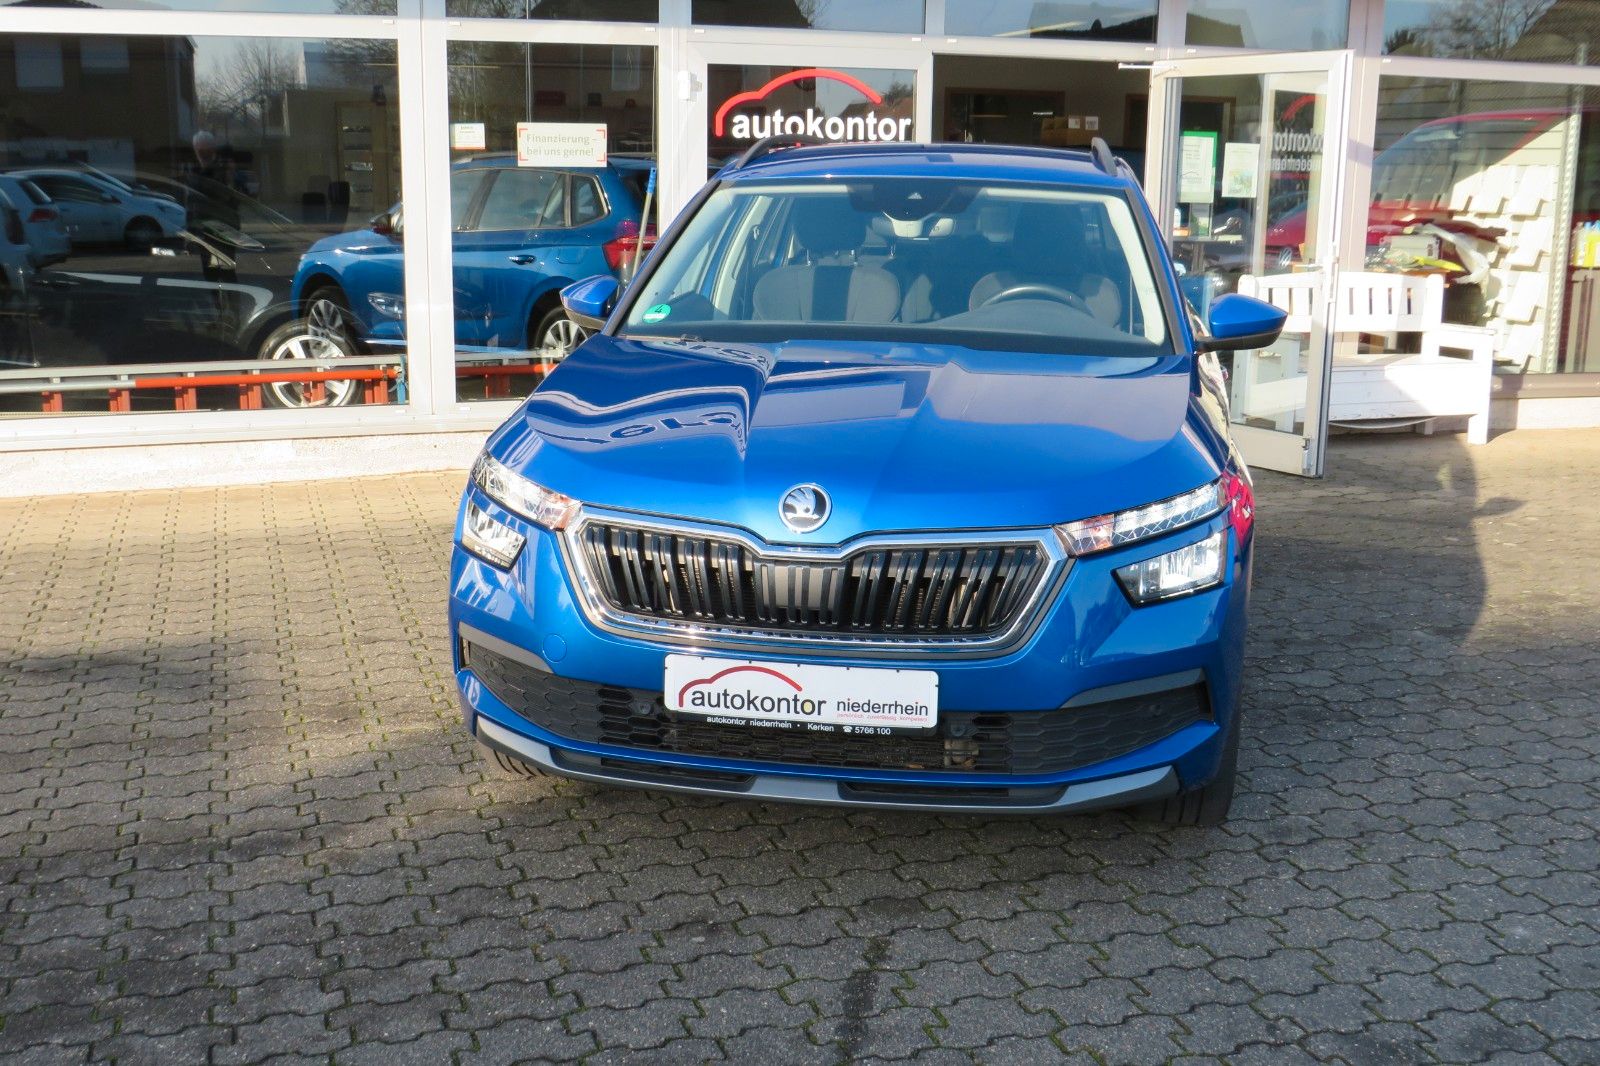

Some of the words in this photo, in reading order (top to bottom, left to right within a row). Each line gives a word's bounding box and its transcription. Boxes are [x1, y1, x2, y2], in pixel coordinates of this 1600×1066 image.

[732, 109, 912, 141] autokontor
[526, 134, 590, 145] Finanzierung
[526, 148, 541, 156] bei
[563, 148, 594, 158] gerne!
[654, 305, 664, 313] 4
[691, 688, 827, 716] autokontor
[836, 698, 928, 716] niederrhein
[706, 716, 746, 726] autokontor
[749, 718, 792, 728] niederrhein
[807, 722, 834, 732] Kerken
[855, 726, 874, 735] 5766
[876, 727, 891, 735] 100
